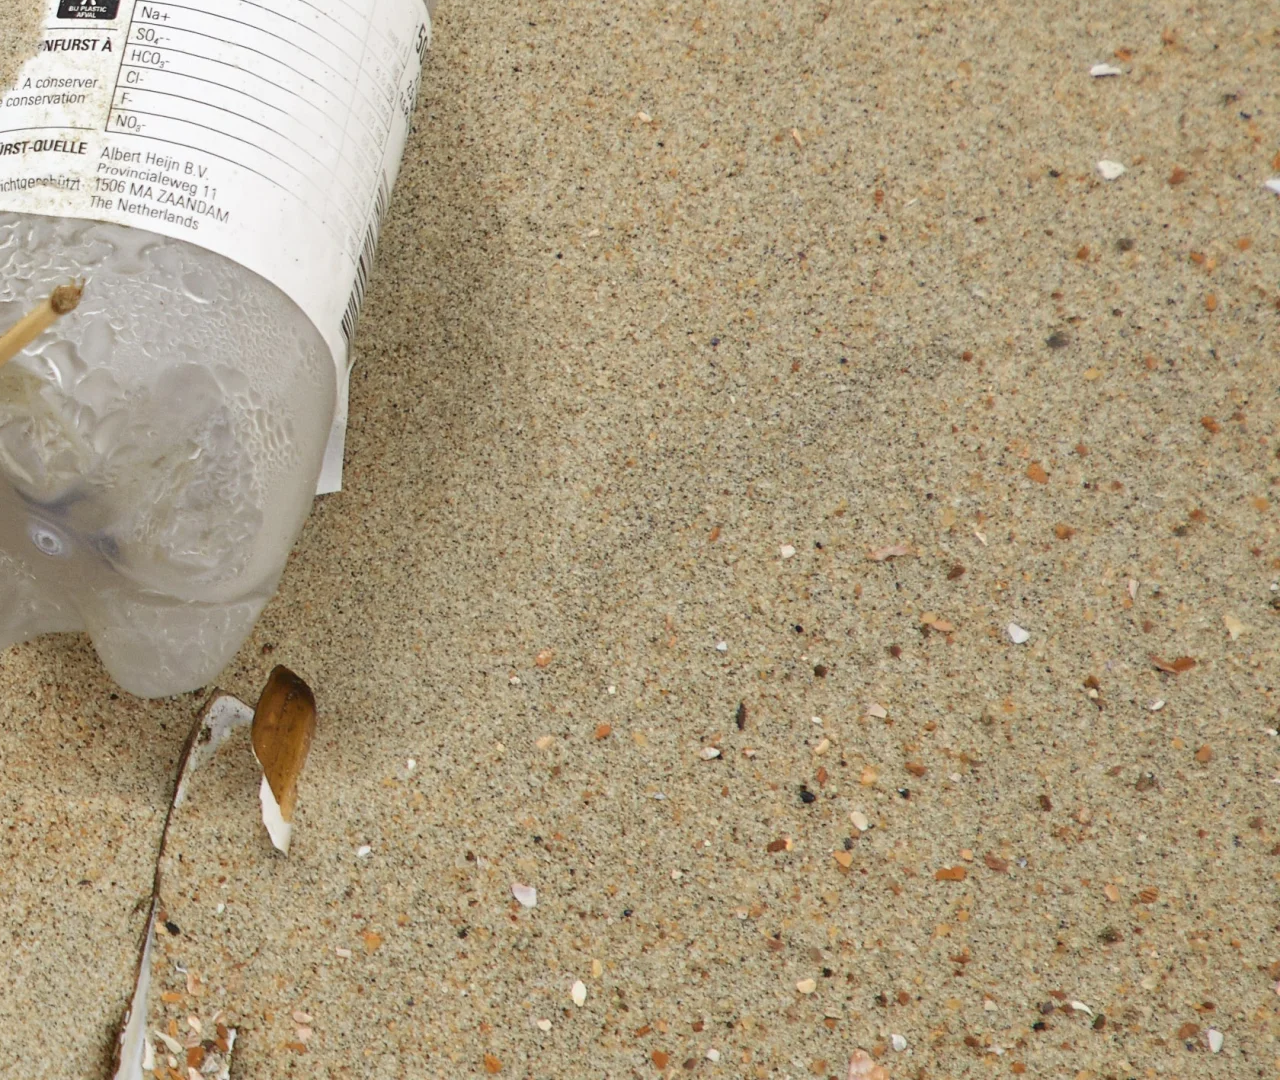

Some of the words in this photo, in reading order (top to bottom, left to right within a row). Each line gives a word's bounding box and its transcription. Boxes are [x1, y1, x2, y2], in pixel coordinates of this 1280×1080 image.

[75, 11, 97, 19] AFVAL
[80, 5, 107, 13] PLASTIC
[141, 6, 171, 22] Na+
[37, 38, 100, 52] NFURST
[101, 36, 113, 52] À
[23, 77, 32, 89] A
[35, 76, 100, 90] conserver
[5, 91, 87, 108] conservation
[100, 146, 141, 164] Albert
[145, 151, 180, 172] Heijn
[184, 161, 210, 181] B.V.
[96, 162, 198, 198] Provincialeweg
[203, 185, 217, 201] 11
[94, 177, 127, 194] 1506
[129, 182, 153, 200] MA
[156, 189, 230, 224] ZAANDAM
[90, 195, 113, 210] The
[117, 198, 200, 230] Netherlands
